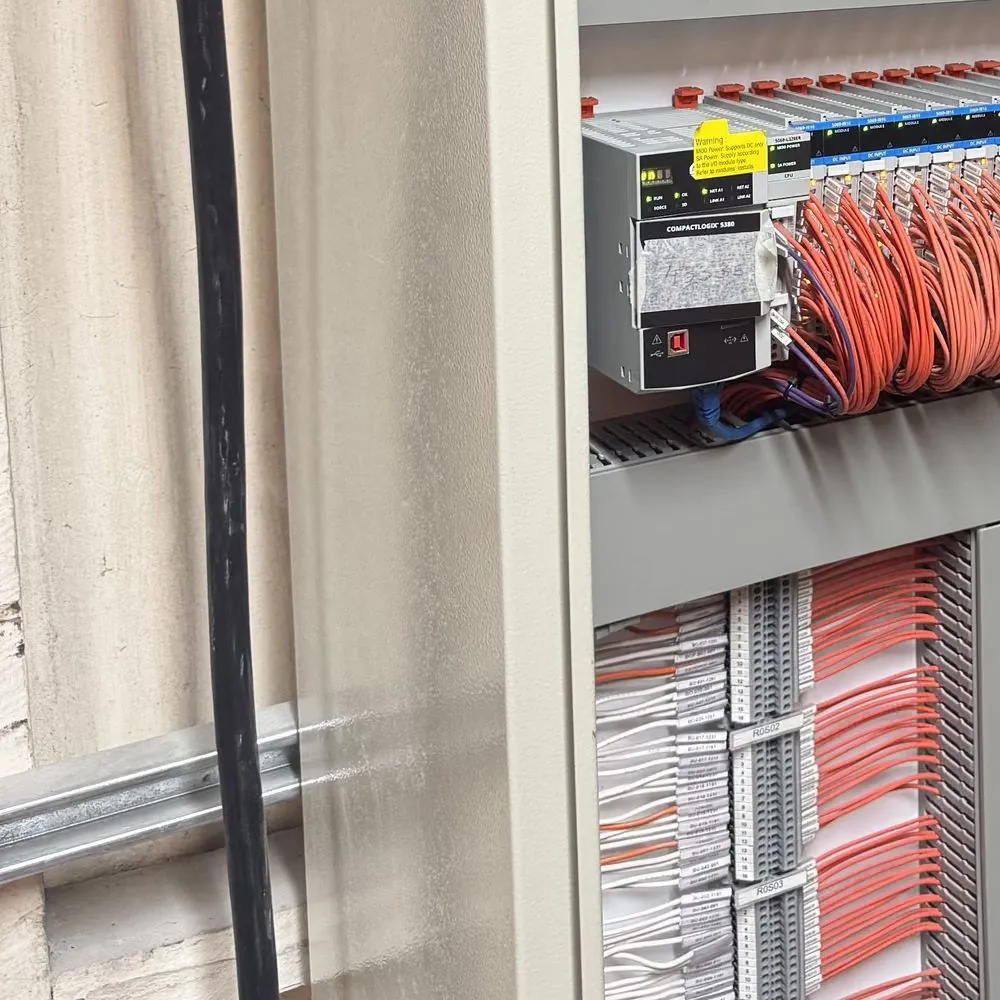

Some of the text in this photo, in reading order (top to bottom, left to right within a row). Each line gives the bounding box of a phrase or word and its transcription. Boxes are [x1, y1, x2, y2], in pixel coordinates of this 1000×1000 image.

[695, 136, 724, 146] Warning
[736, 149, 760, 157] according
[719, 220, 735, 228] 5380
[752, 722, 780, 738] R0S02
[756, 880, 784, 896] R0S03
